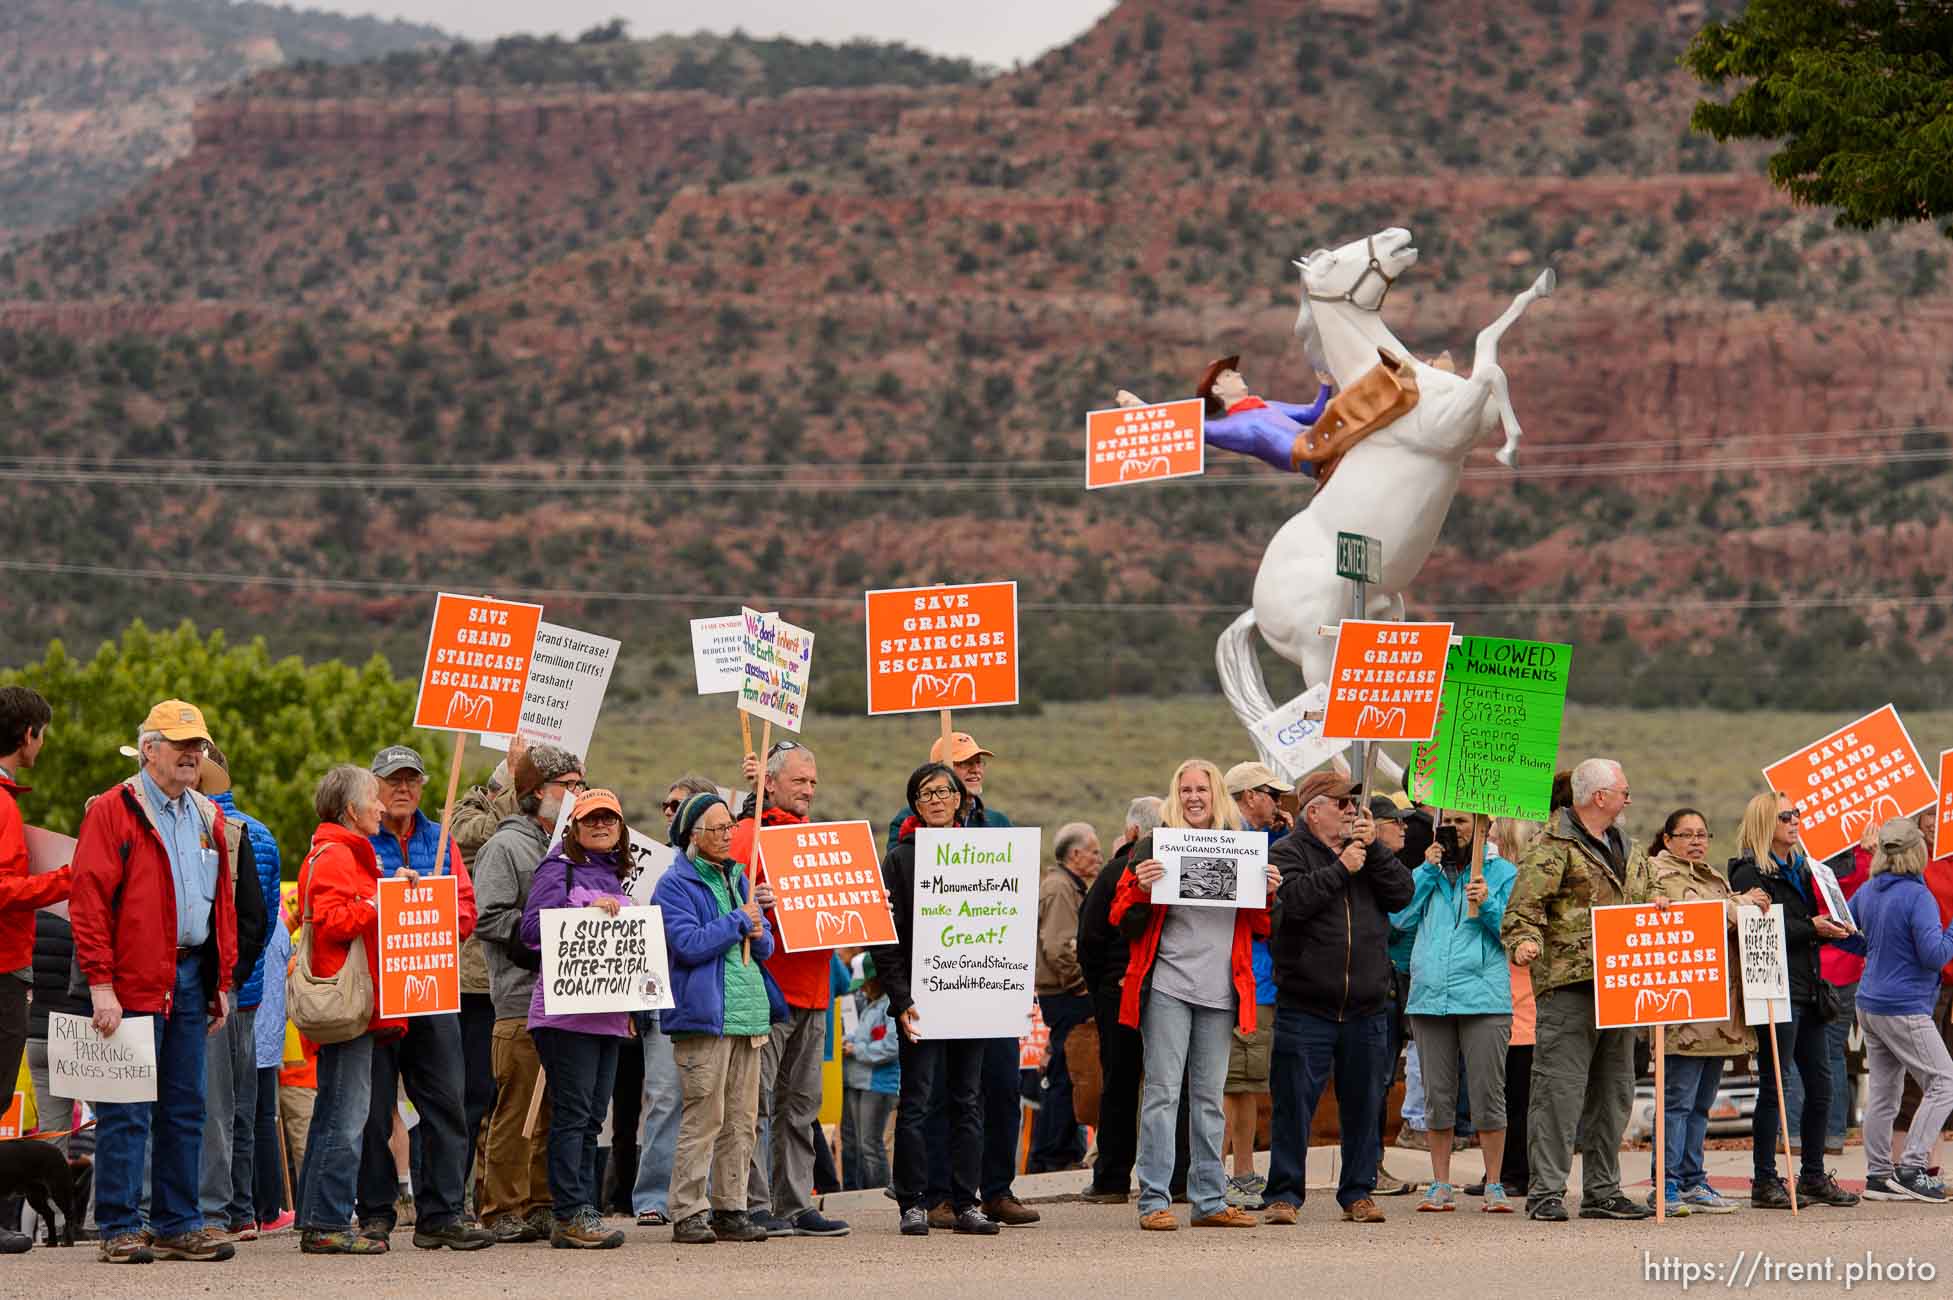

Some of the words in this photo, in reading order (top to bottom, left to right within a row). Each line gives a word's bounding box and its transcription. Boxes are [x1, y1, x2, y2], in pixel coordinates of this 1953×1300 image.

[1124, 408, 1167, 422] SAVE
[1115, 419, 1176, 436] GRAND
[1096, 428, 1194, 451] STAIRCASE
[1095, 441, 1195, 463] ESCALANTE
[914, 594, 969, 611] SAVE
[469, 607, 508, 625] SAVE
[903, 613, 981, 632] GRAND
[457, 628, 511, 648] GRAND
[744, 612, 758, 637] We
[777, 631, 799, 653] inherit
[1377, 630, 1420, 645] SAVE
[563, 639, 609, 658] Staircase!
[743, 634, 756, 656] the
[757, 640, 774, 664] Earth
[880, 631, 1005, 655] STAIRCASE
[436, 648, 524, 671] STAIRCASE
[879, 651, 1007, 674] ESCALANTE
[1363, 650, 1423, 665] GRAND
[576, 661, 604, 678] Cliffs!
[1341, 668, 1436, 684] STAIRCASE
[1466, 659, 1557, 681] MONUMENTS
[430, 670, 521, 693] ESCALANTE
[530, 671, 574, 690] arashant!
[781, 672, 800, 695] borrow
[525, 691, 545, 705] ears
[546, 695, 569, 711] Ears!
[743, 677, 759, 701] from
[760, 691, 771, 705] our
[1335, 687, 1434, 703] ESCALANTE
[1466, 685, 1524, 706] Hunting
[1463, 697, 1527, 720] Grazing
[1463, 709, 1482, 720] Oil
[1496, 714, 1520, 727] Gas
[521, 711, 535, 723] old
[537, 712, 563, 729] Butte!
[1461, 722, 1519, 745] Camping
[1463, 734, 1516, 757] Fishing
[1808, 732, 1859, 766] SAVE
[1459, 759, 1500, 779] Hiking
[1520, 755, 1551, 774] Riding
[1807, 744, 1876, 786] GRAND
[1795, 748, 1905, 813] STAIRCASE
[1802, 763, 1916, 831] ESCALANTE
[796, 831, 840, 848] SAVE
[792, 851, 853, 869] GRAND
[936, 841, 1013, 866] National
[778, 869, 874, 890] STAIRCASE
[920, 874, 1019, 894] #MonumentsForAll
[404, 887, 433, 903] SAVE
[781, 890, 881, 911] ESCALANTE
[398, 909, 439, 926] GRAND
[921, 903, 952, 916] make
[957, 899, 1018, 918] America
[1635, 911, 1684, 927] SAVE
[559, 920, 566, 940] I
[574, 919, 647, 940] SUPPORT
[941, 924, 1009, 947] Great!
[1626, 930, 1695, 947] GRAND
[386, 930, 453, 950] STAIRCASE
[558, 938, 607, 959] BEARS
[615, 938, 646, 956] EARS
[385, 953, 454, 973] ESCALANTE
[557, 957, 649, 978] INTER-TRIBAL
[923, 954, 1029, 971] #SaveGrandStaircase
[1605, 948, 1717, 969] STAIRCASE
[553, 976, 632, 997] COALITION!
[1604, 968, 1719, 989] ESCALANTE
[74, 1040, 134, 1063] PARKING
[107, 1064, 155, 1080] STREET
